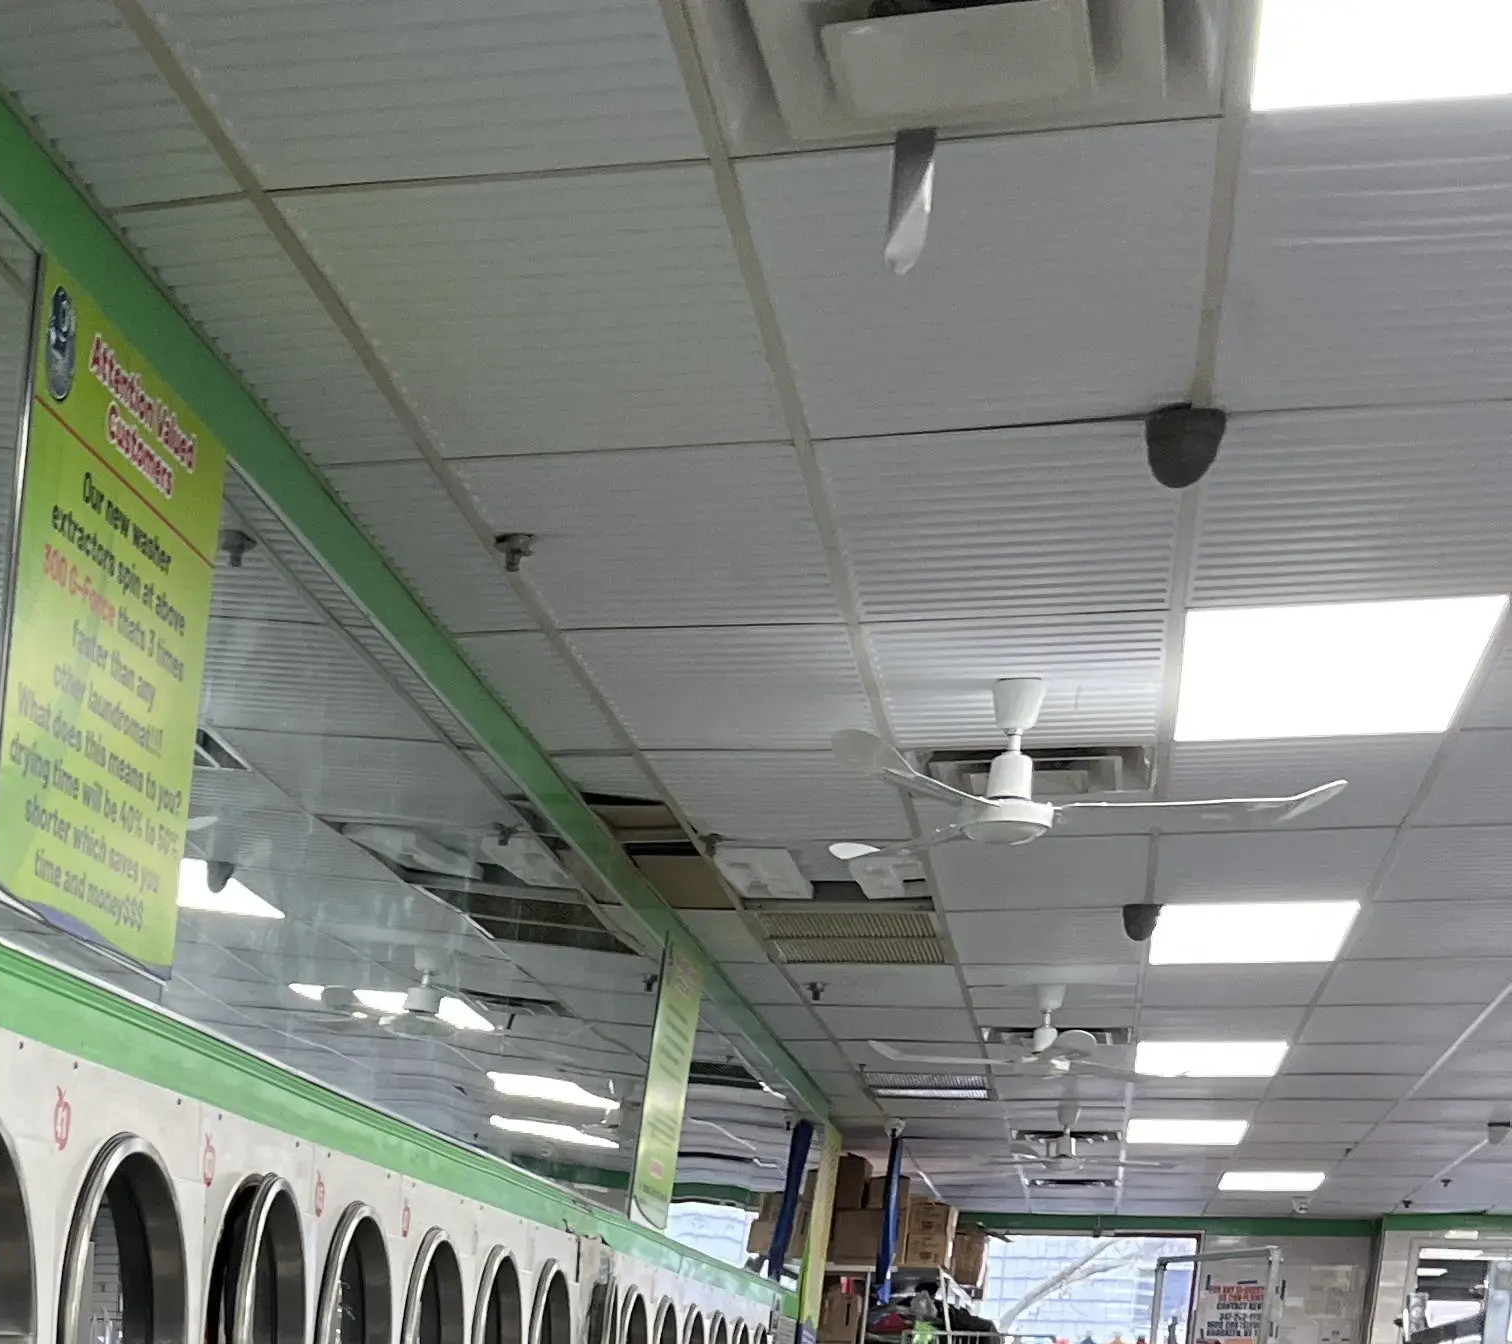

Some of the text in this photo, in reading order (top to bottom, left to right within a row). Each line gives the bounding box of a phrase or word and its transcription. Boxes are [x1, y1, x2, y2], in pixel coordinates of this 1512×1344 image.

[89, 333, 198, 474] Attention Valued
[106, 400, 174, 499] Customers
[52, 504, 185, 636] extractors spin at above
[83, 472, 171, 575] Our new washer
[110, 651, 135, 692] than
[137, 676, 155, 713] any
[118, 606, 145, 652] thats
[148, 628, 156, 657] 3
[157, 638, 184, 682] times
[10, 733, 50, 789] drying
[52, 758, 79, 800] time
[82, 779, 103, 813] will
[104, 789, 117, 824] be
[120, 801, 143, 840] 40%
[145, 817, 156, 846] to
[17, 682, 182, 817] What does this means to you?
[25, 792, 160, 895] shorter which saves you
[35, 848, 61, 889] time
[63, 868, 86, 900] and
